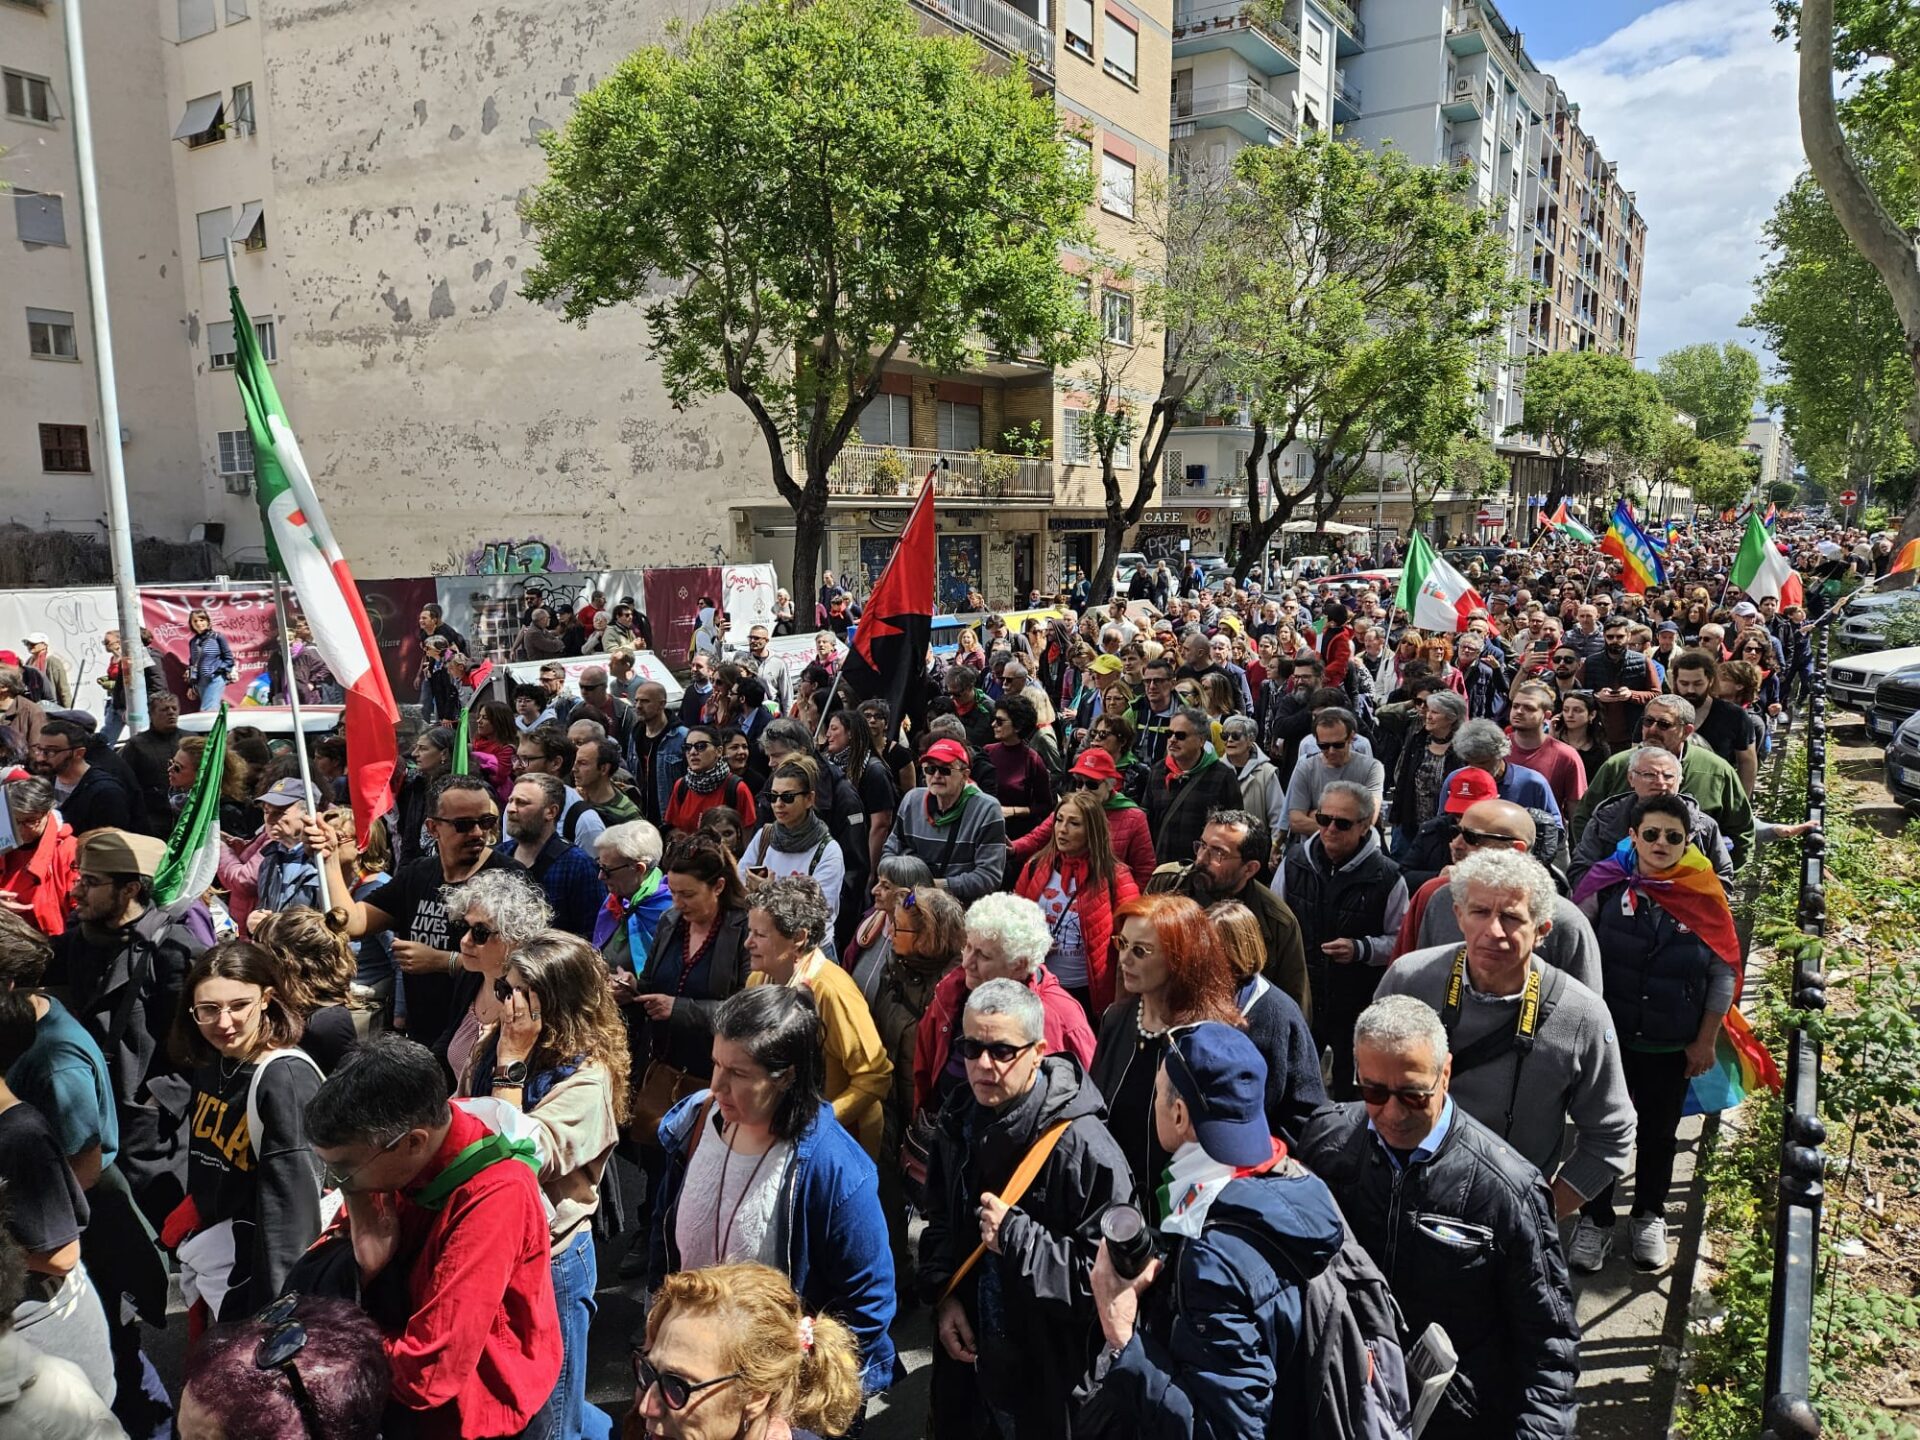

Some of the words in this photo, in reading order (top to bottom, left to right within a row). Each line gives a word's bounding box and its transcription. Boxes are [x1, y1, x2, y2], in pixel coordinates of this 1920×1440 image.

[1144, 512, 1183, 523] CAFE'
[411, 915, 448, 934] LIVES
[1448, 976, 1461, 1007] Nikon
[1524, 971, 1539, 1001] D750
[1521, 1003, 1536, 1034] Nikon
